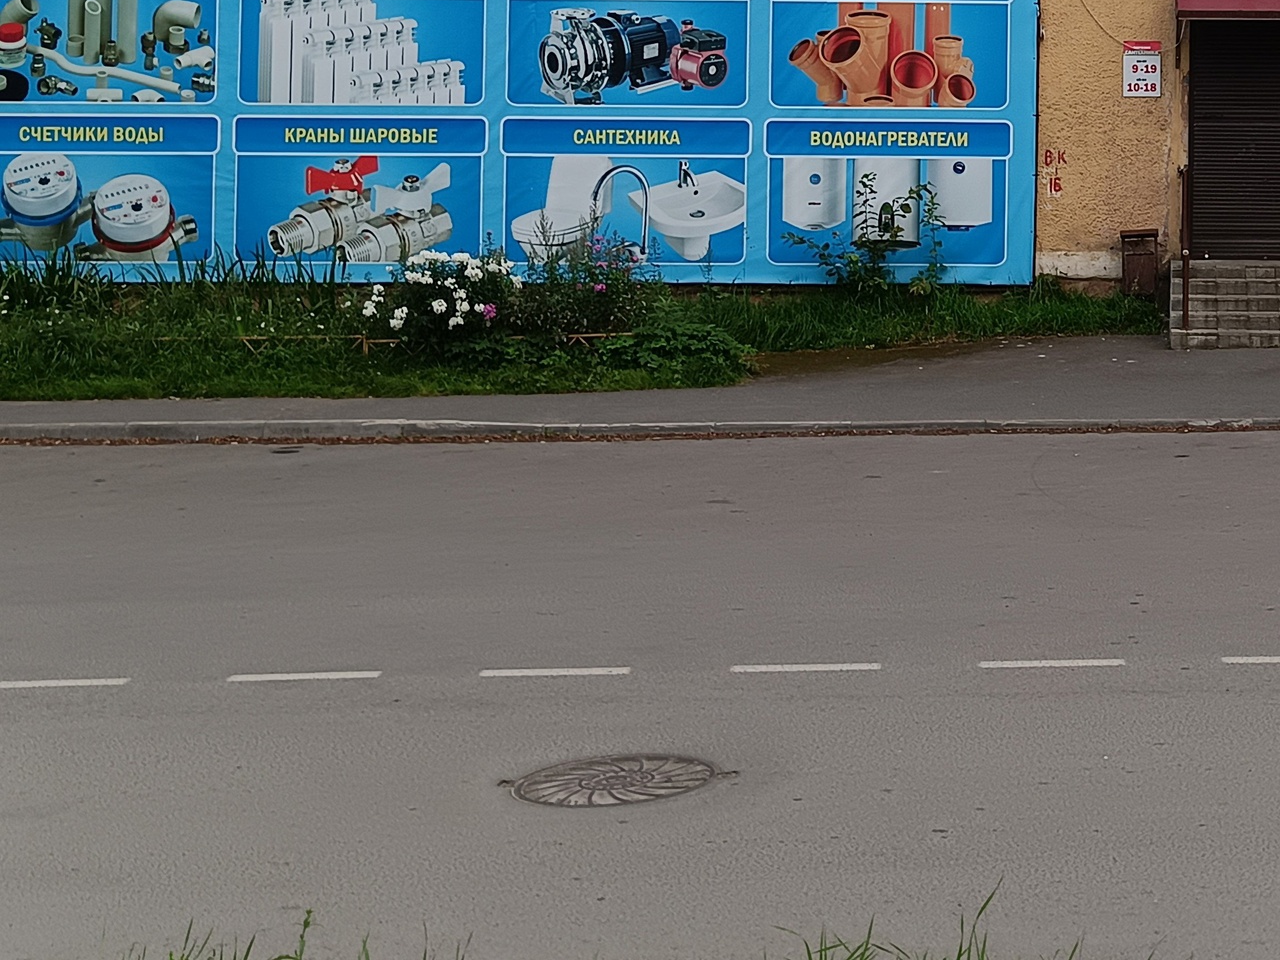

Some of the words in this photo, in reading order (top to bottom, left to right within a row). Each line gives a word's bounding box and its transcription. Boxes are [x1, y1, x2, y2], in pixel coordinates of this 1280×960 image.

[1127, 82, 1157, 92] 10-18
[19, 126, 109, 143] СЧЕТЧИКИ
[112, 127, 164, 145] ВОДЫ
[284, 127, 345, 144] КРАНЫ
[349, 127, 438, 144] ШАРОВЫЕ
[573, 128, 680, 146] САНТЕХНИКА
[809, 130, 969, 149] ВОДОНАГРЕВАТЕЛИ
